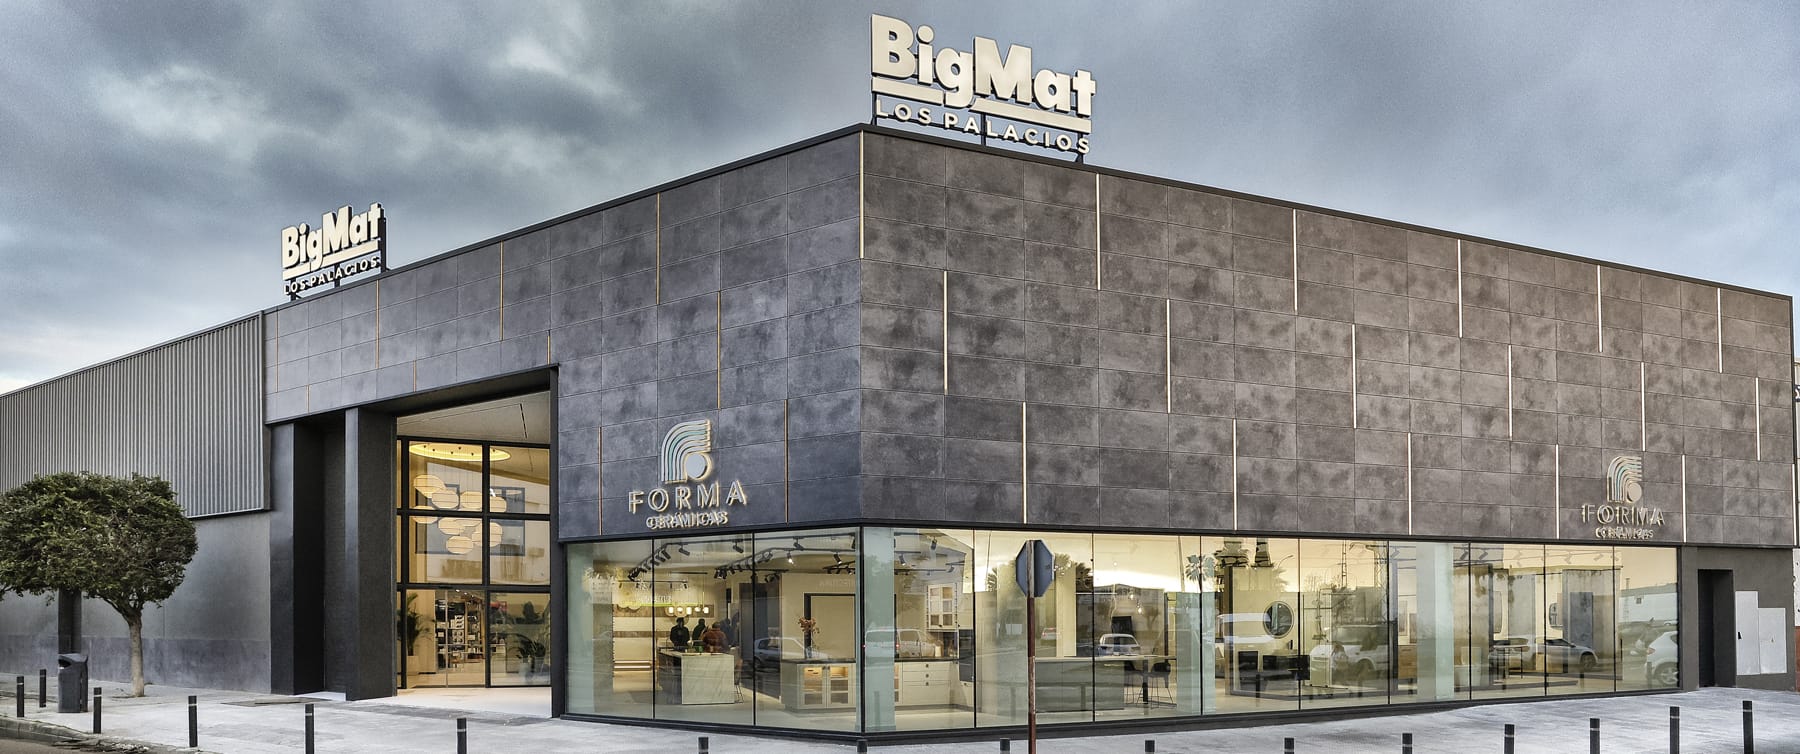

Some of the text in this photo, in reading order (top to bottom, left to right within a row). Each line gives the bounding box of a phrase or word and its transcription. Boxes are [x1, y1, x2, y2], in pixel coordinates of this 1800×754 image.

[871, 13, 1096, 117] BigMat
[876, 98, 1090, 154] LOS PALACIOS
[281, 202, 385, 273] BigMat
[283, 255, 380, 295] LOS PALACIOS
[628, 479, 748, 514] FORMA
[1581, 503, 1665, 526] FORMA
